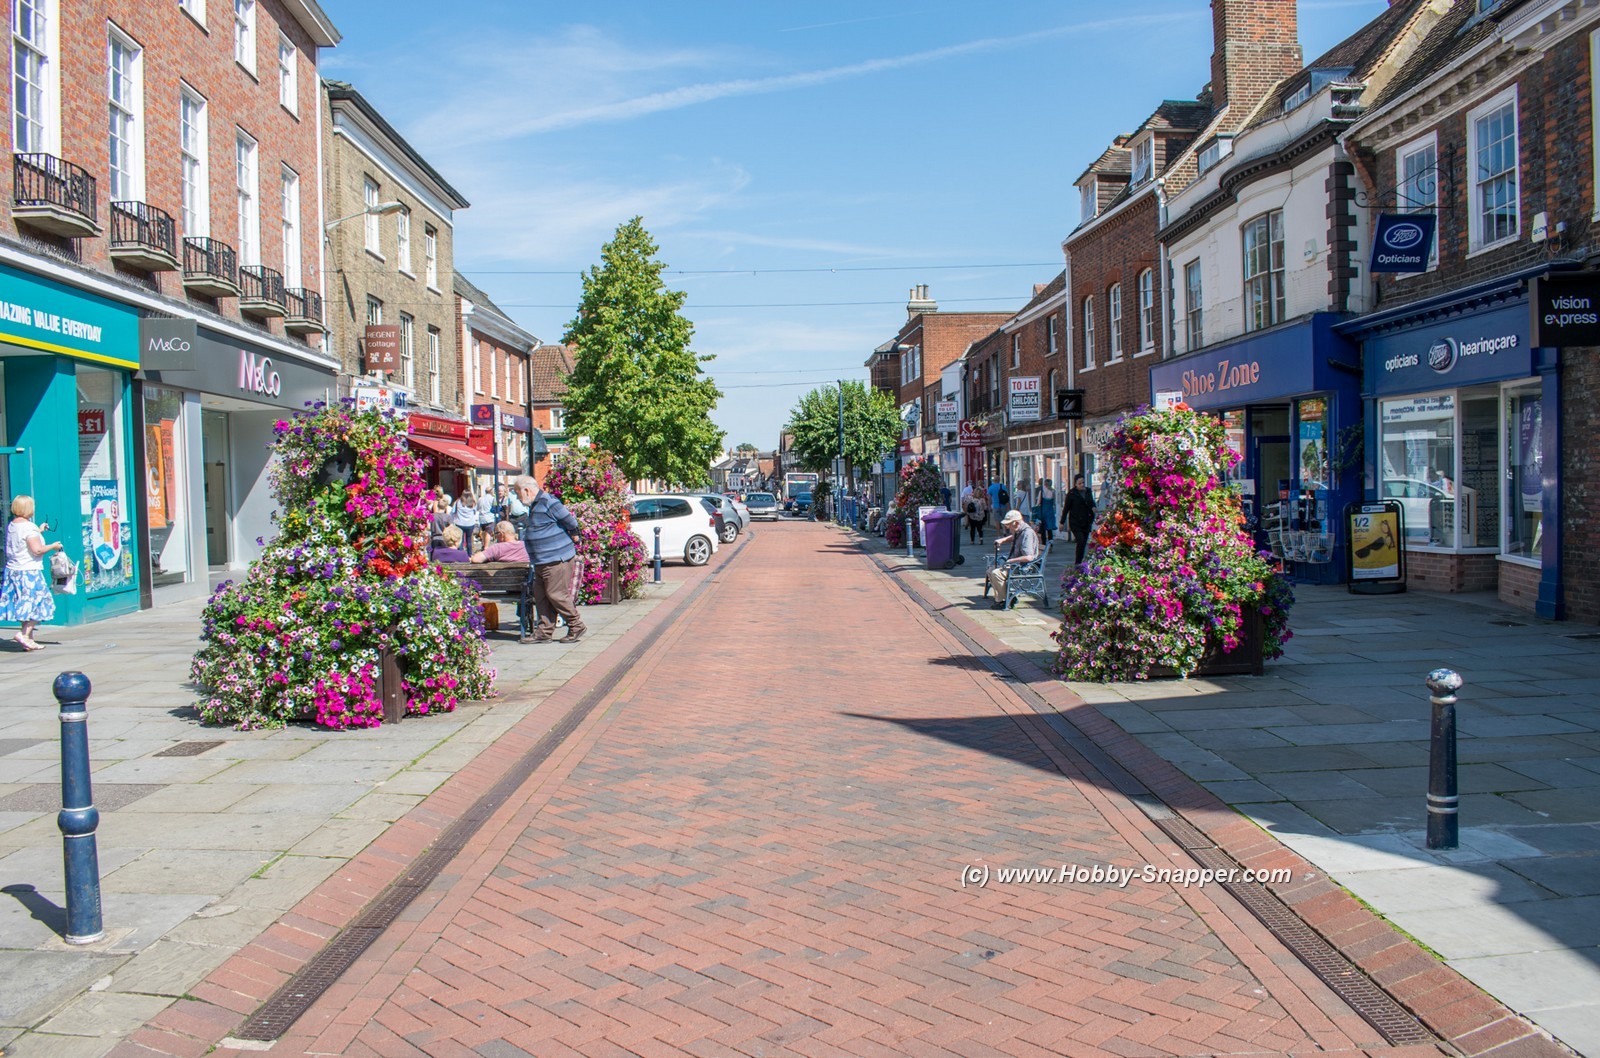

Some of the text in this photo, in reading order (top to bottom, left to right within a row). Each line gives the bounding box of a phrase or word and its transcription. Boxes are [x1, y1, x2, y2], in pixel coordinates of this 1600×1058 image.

[1378, 255, 1421, 264] Opticians
[1552, 296, 1590, 309] vision
[33, 309, 61, 333] VALUE
[62, 317, 102, 343] EVERYDAY
[1544, 313, 1598, 327] express
[149, 337, 191, 352] M&Co
[1385, 354, 1419, 372] opticians
[1460, 335, 1518, 356] hearingcare
[238, 350, 281, 397] M&Co
[1182, 360, 1260, 398] Shoe Zone
[1012, 381, 1038, 391] TO LET
[1012, 396, 1038, 405] SHILCOCK
[86, 418, 102, 432] £1
[1353, 517, 1369, 528] 1/2
